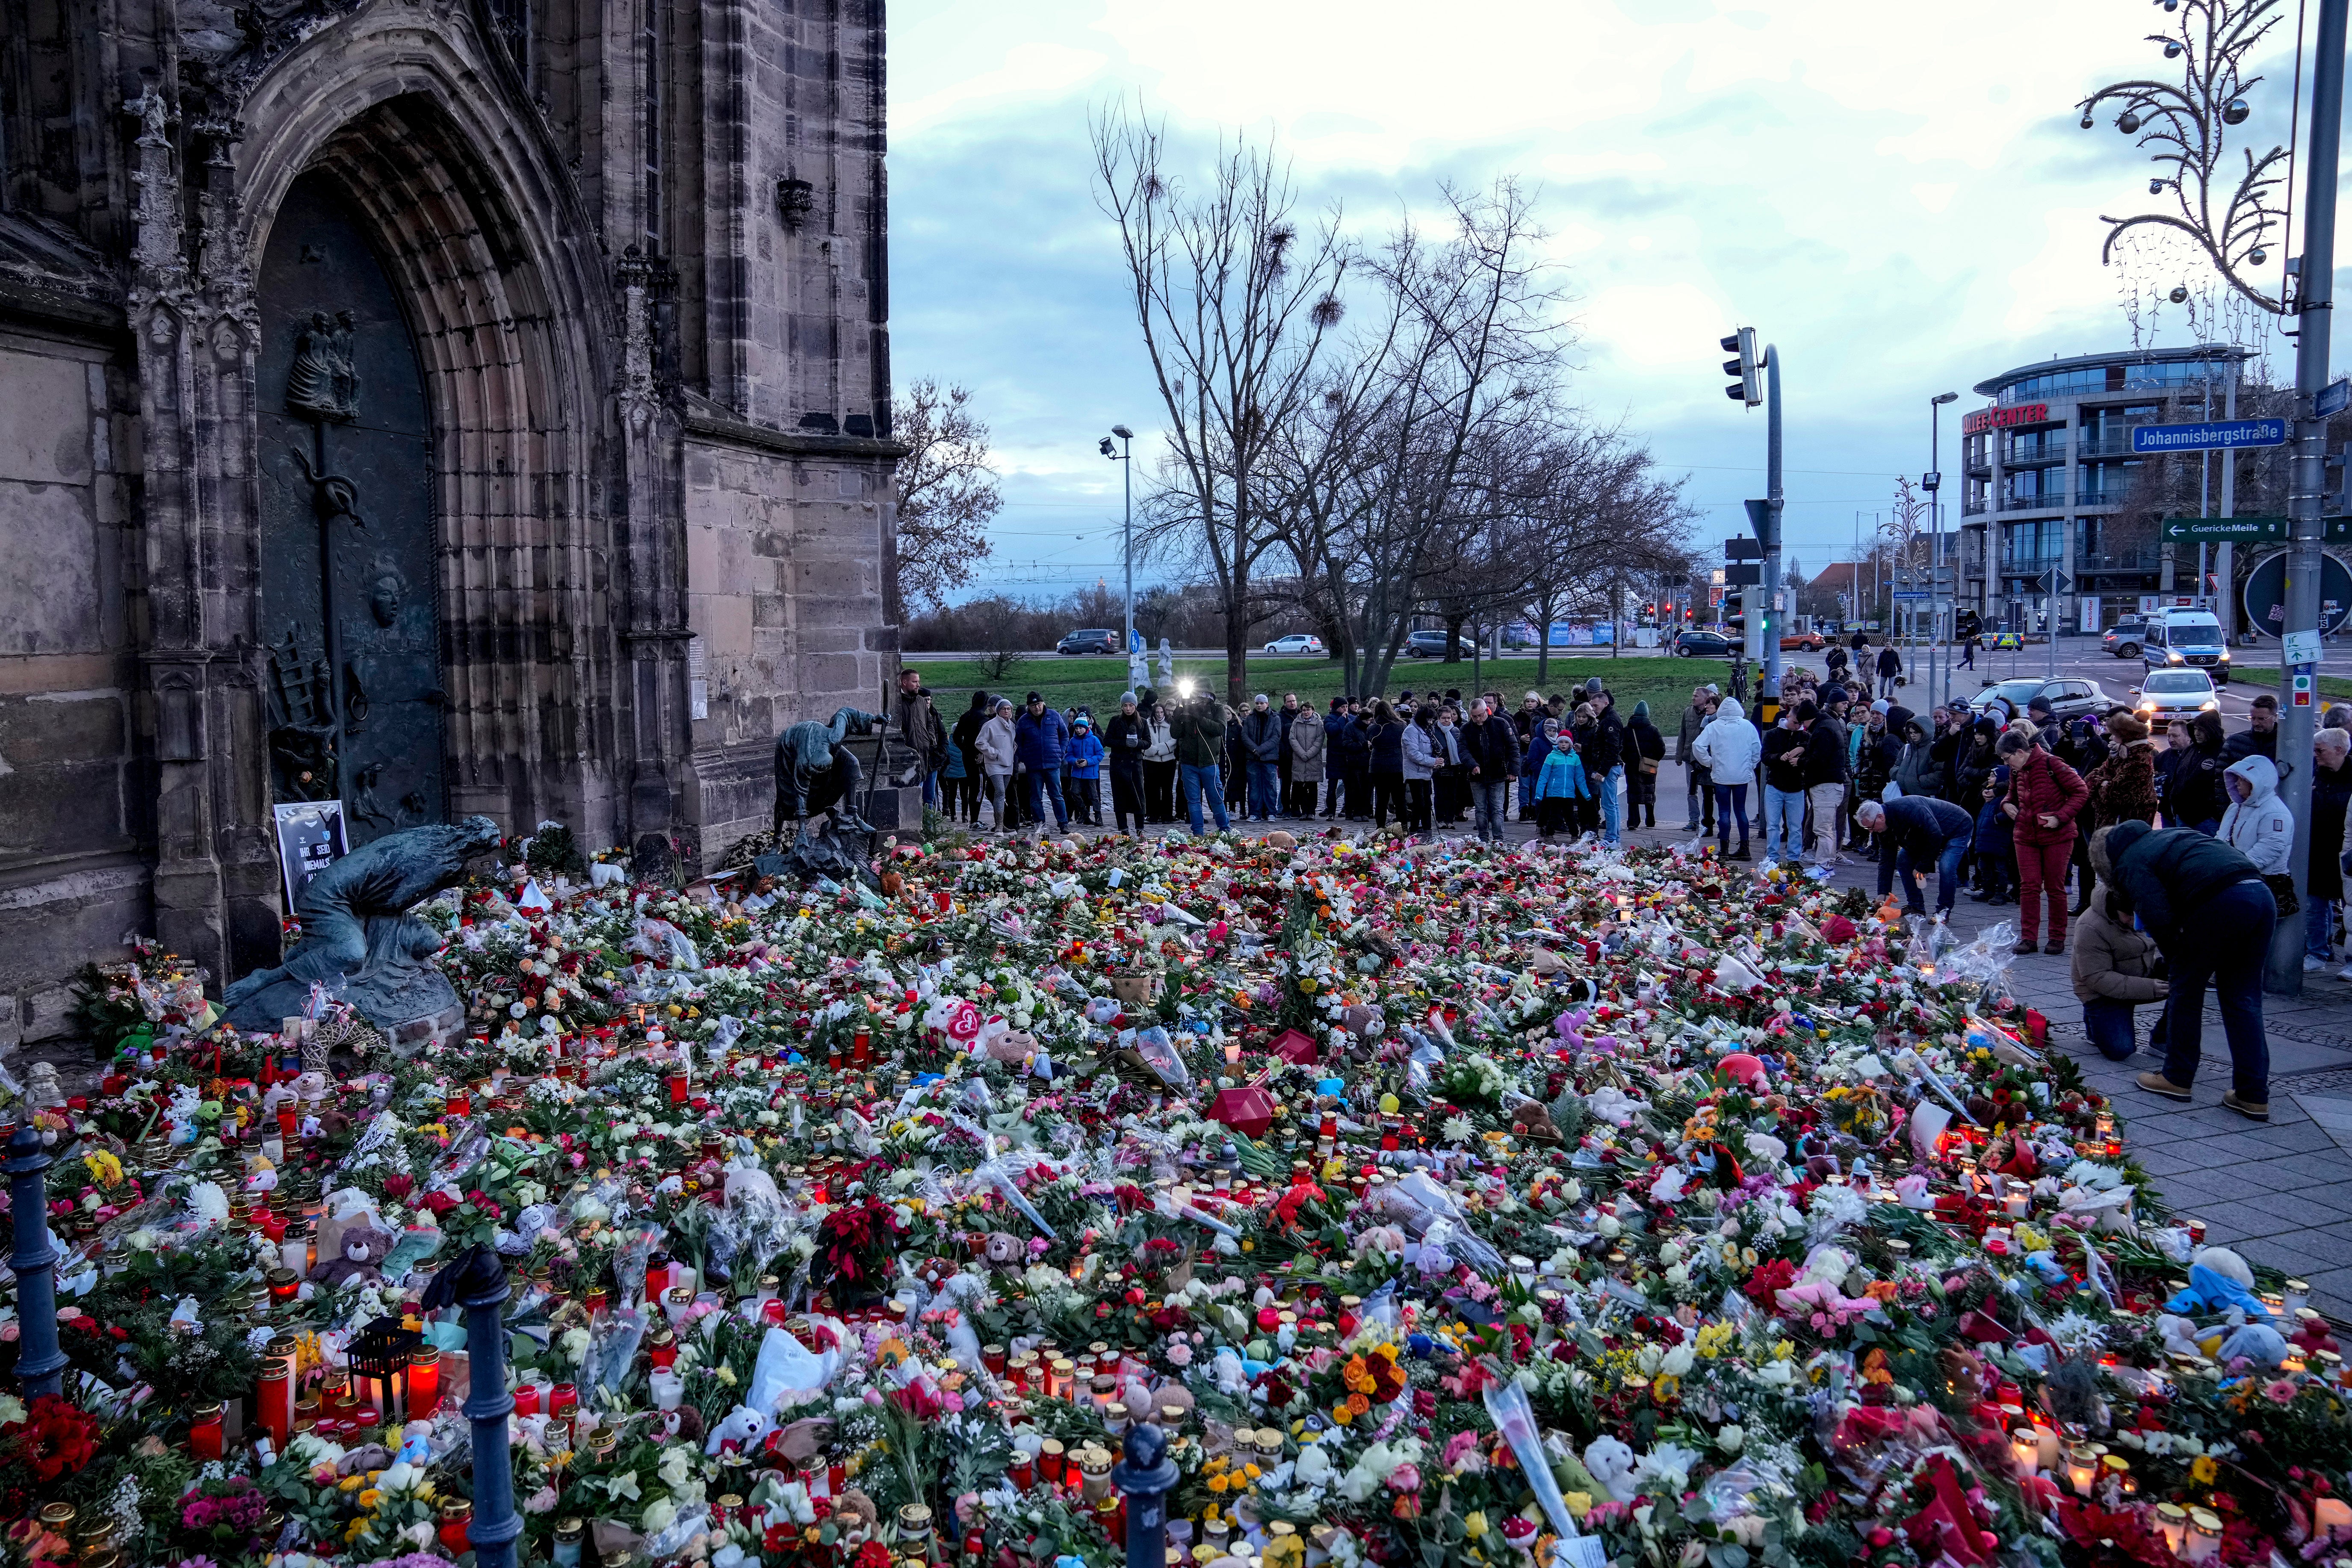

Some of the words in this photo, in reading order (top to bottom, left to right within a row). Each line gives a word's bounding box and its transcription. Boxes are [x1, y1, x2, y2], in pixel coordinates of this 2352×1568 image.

[2140, 424, 2278, 446] Johannisbergstraße
[2191, 523, 2258, 533] GuerickeMeile
[299, 847, 311, 857] IHR
[316, 844, 331, 855] SEID
[304, 858, 330, 871] NIEMALS
